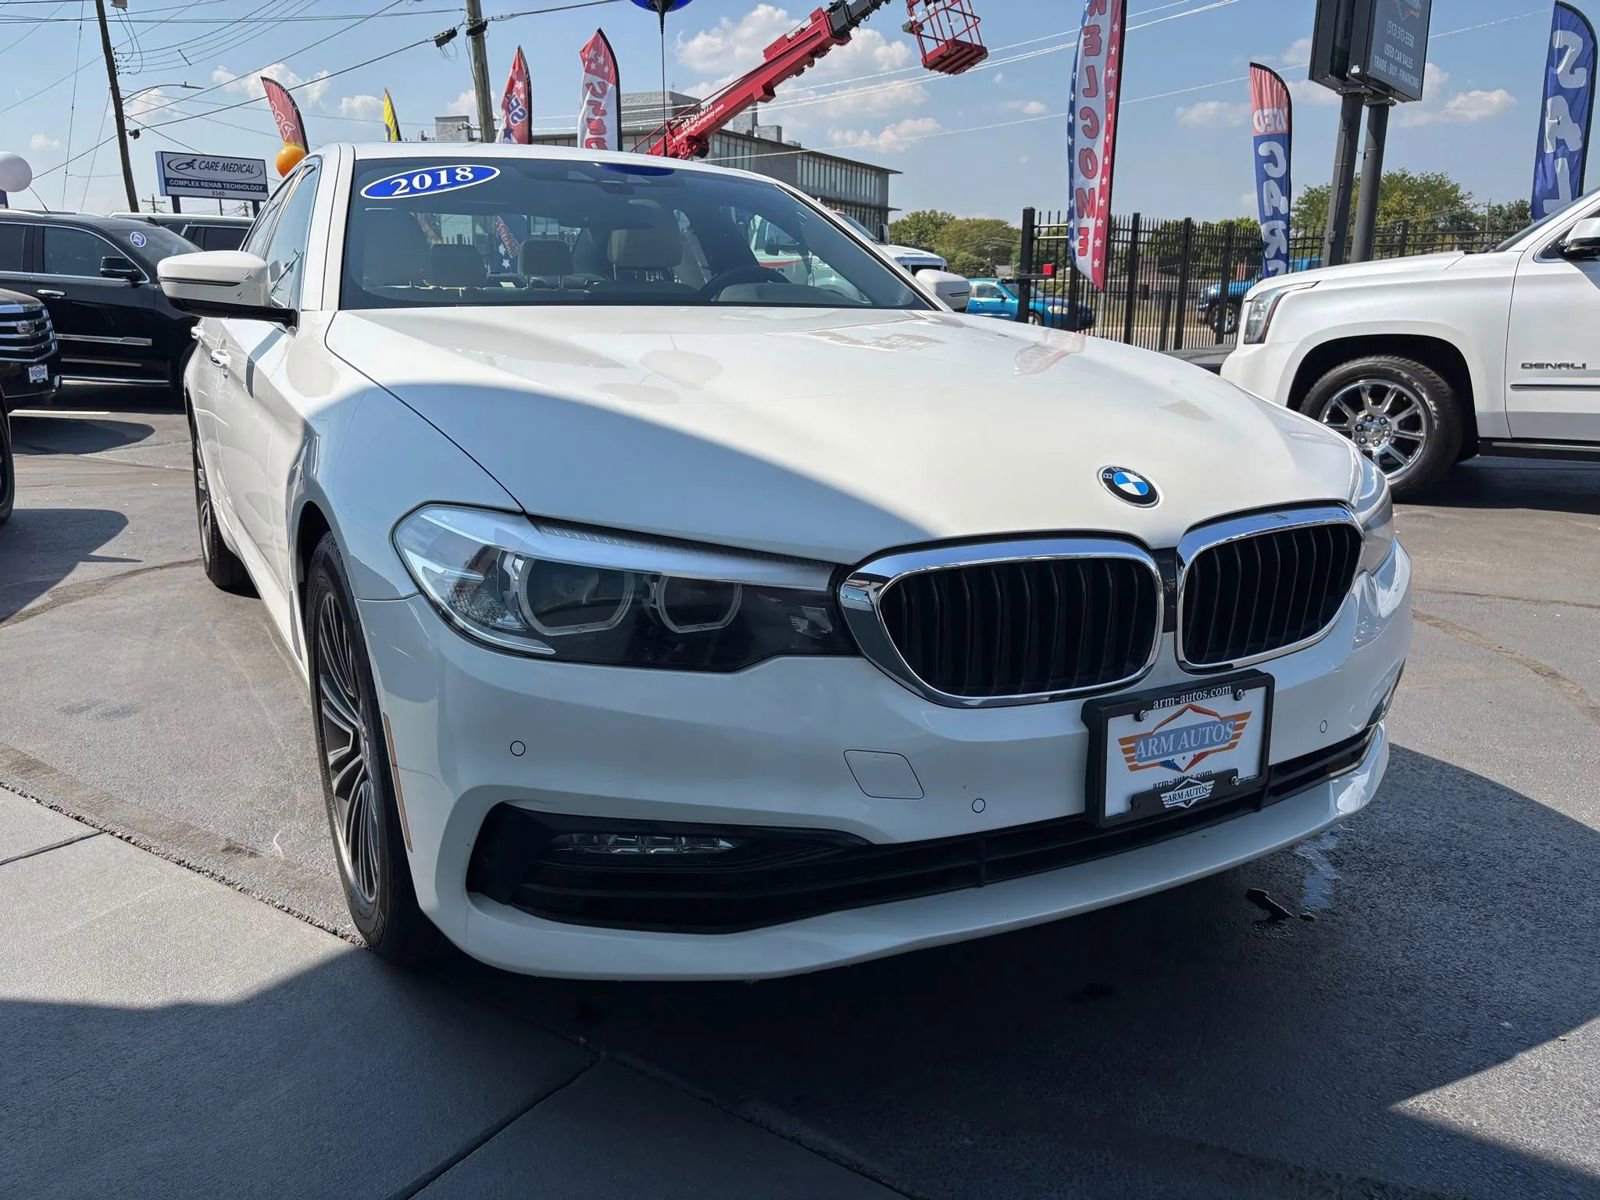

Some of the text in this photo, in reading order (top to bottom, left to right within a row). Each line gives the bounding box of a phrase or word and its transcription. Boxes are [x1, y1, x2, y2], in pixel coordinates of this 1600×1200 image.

[1384, 43, 1395, 58] USED
[1402, 52, 1414, 69] SALES
[198, 160, 254, 174] CARE MEDICAL
[169, 179, 263, 191] COMPLEX REHAB TECHNOLOGY
[390, 166, 475, 196] 2018
[1153, 685, 1232, 709] arm-autos.com
[1135, 721, 1235, 759] ARM AUTOS
[1168, 785, 1208, 802] ARM AUTOS
